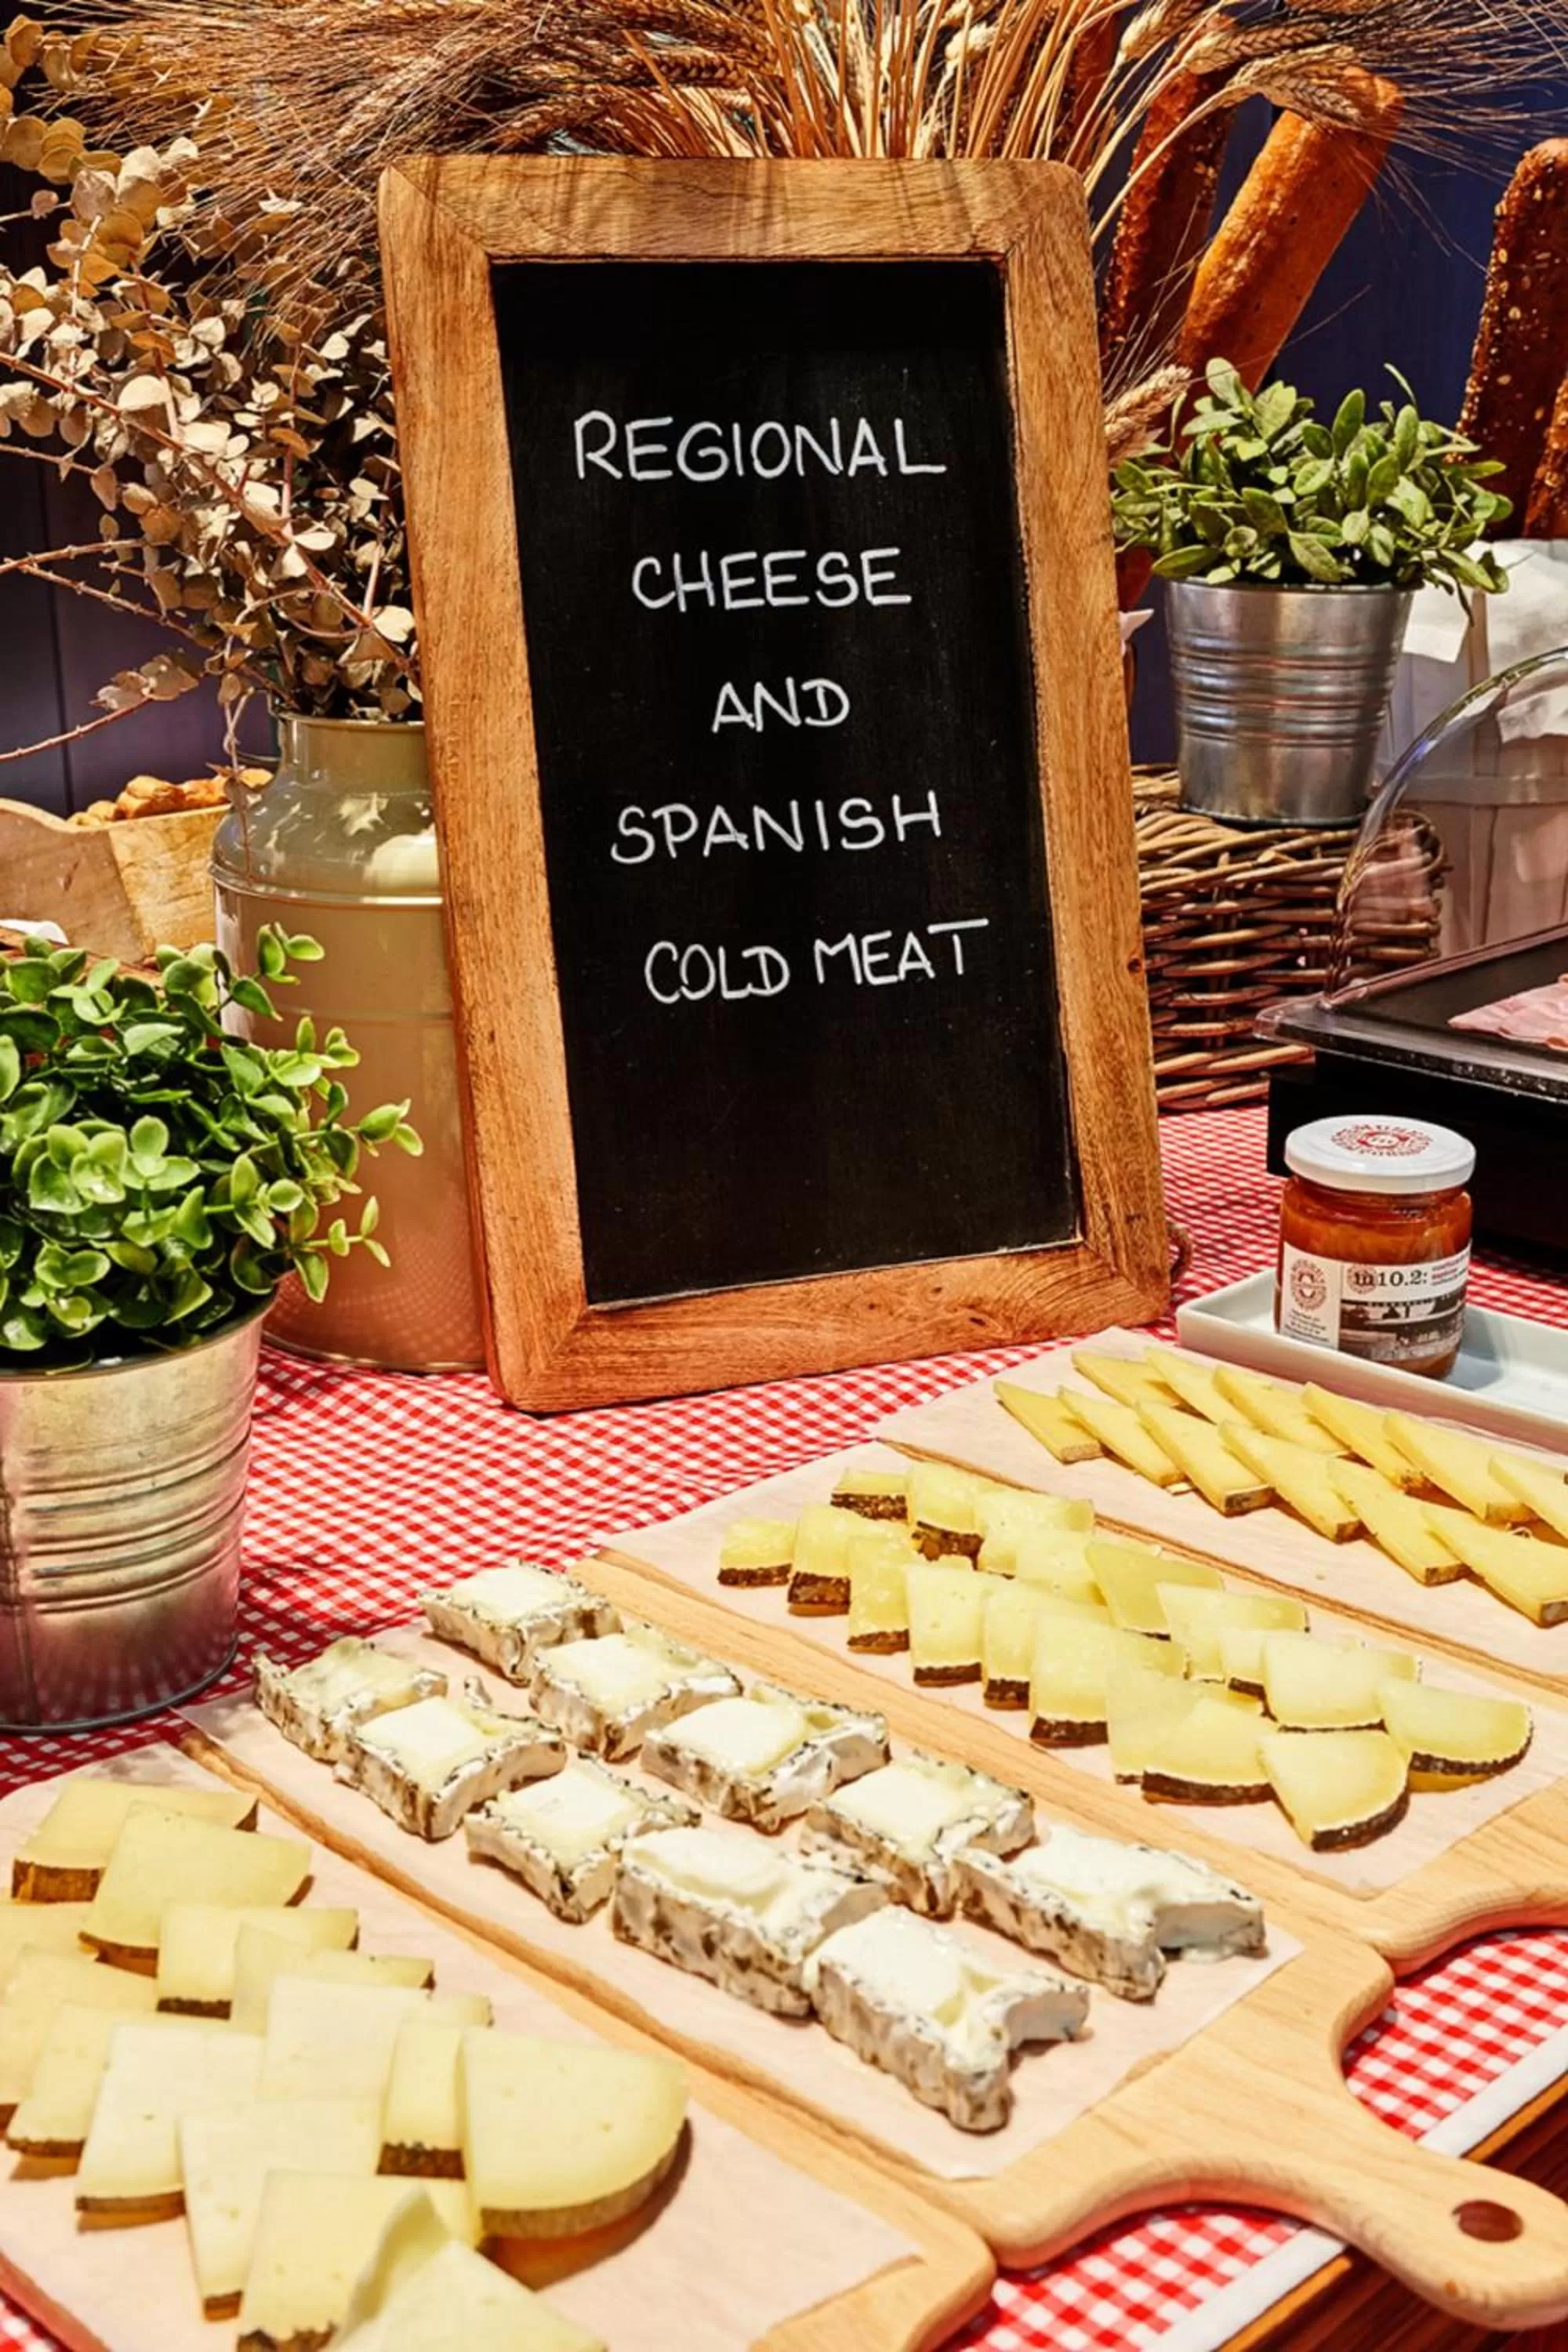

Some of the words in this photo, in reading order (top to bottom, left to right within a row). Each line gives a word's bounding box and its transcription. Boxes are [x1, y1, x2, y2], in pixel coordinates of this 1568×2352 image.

[575, 411, 946, 481] REGIONAL
[633, 548, 911, 612] CHEESE
[713, 677, 850, 733] AND
[612, 791, 941, 863] SPANISH
[645, 942, 790, 1004] COLD
[815, 919, 989, 985] MEAT
